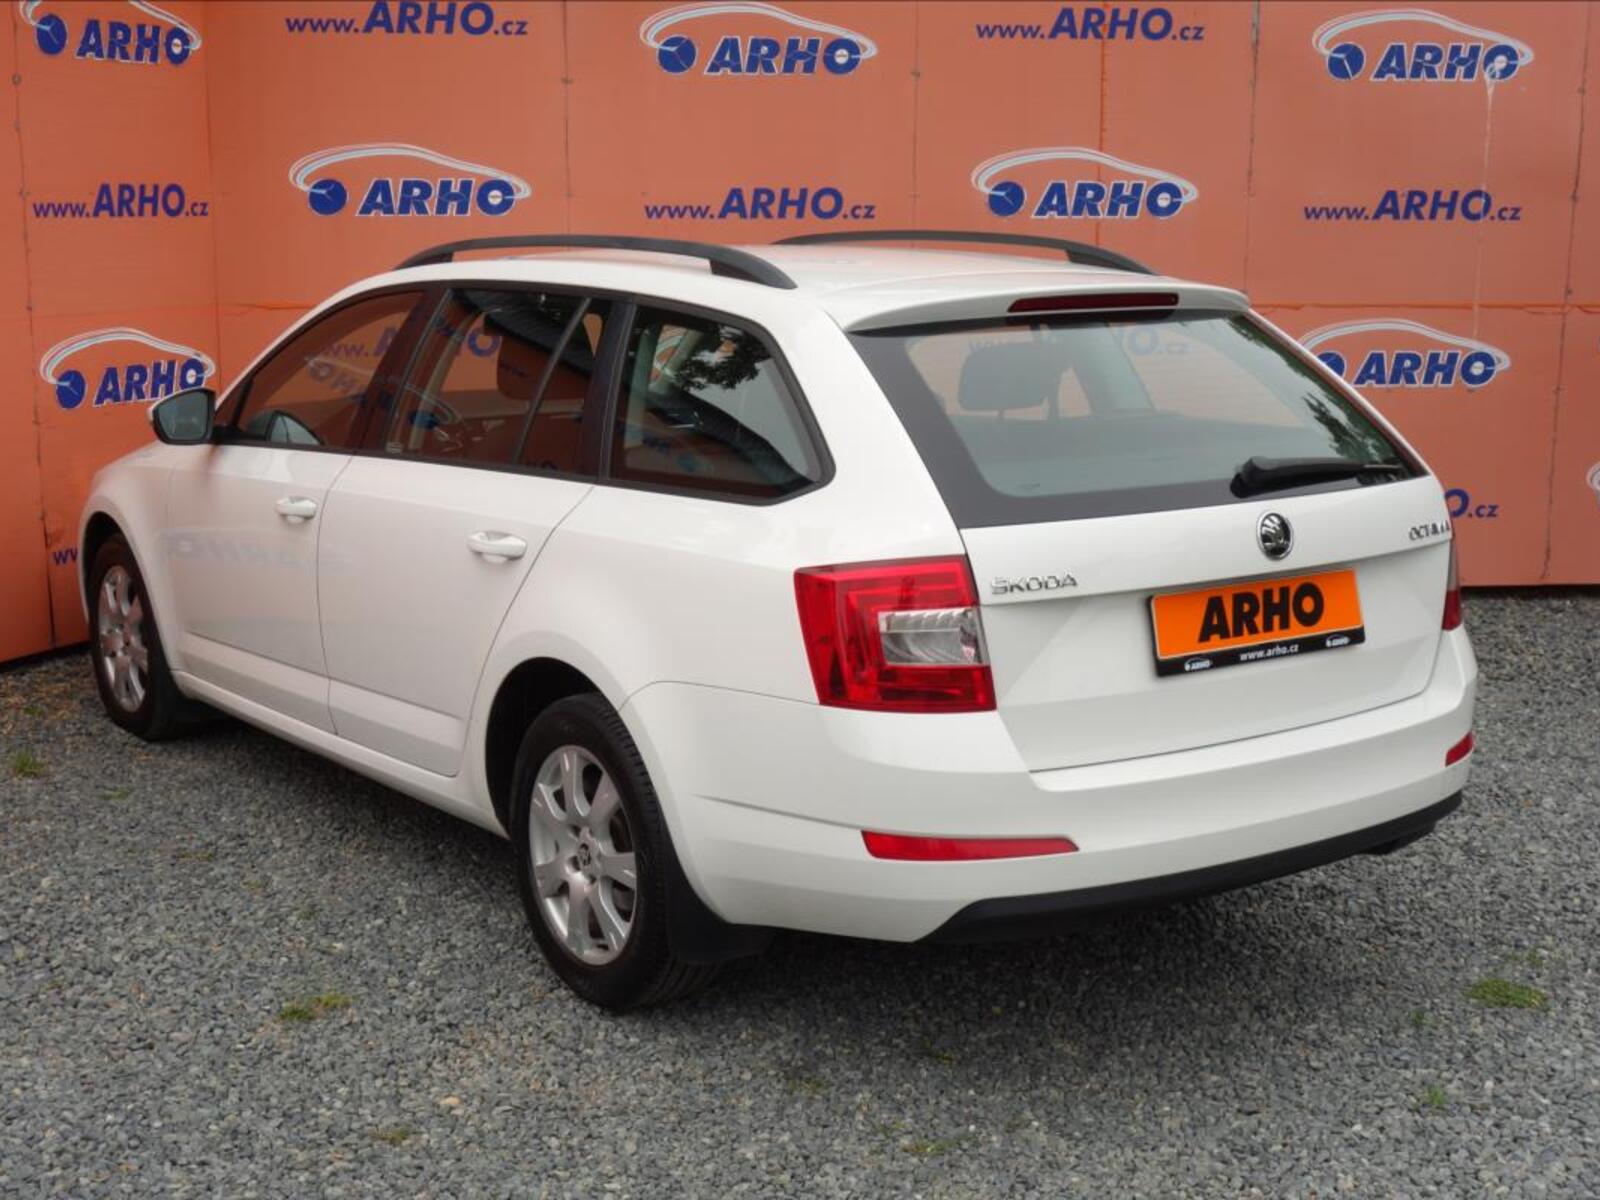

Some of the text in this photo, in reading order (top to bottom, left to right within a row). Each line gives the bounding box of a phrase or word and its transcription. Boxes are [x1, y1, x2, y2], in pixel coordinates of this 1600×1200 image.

[286, 1, 528, 37] www.ARHO.cz
[976, 7, 1205, 41] www.ARHO.cz
[76, 19, 191, 65] ARHO
[706, 36, 862, 76] ARHO
[1372, 42, 1520, 81] ARHO
[33, 184, 209, 218] www.ARHO.cz
[358, 177, 516, 217] ARHO
[645, 187, 876, 220] www.ARHO.cz
[1033, 181, 1184, 219] ARHO
[1304, 189, 1522, 222] www.ARHO.cz
[94, 357, 205, 405] ARHO
[1353, 349, 1497, 387] ARHO
[1197, 581, 1325, 643] ARHO
[1240, 644, 1299, 661] www.arho.cz
